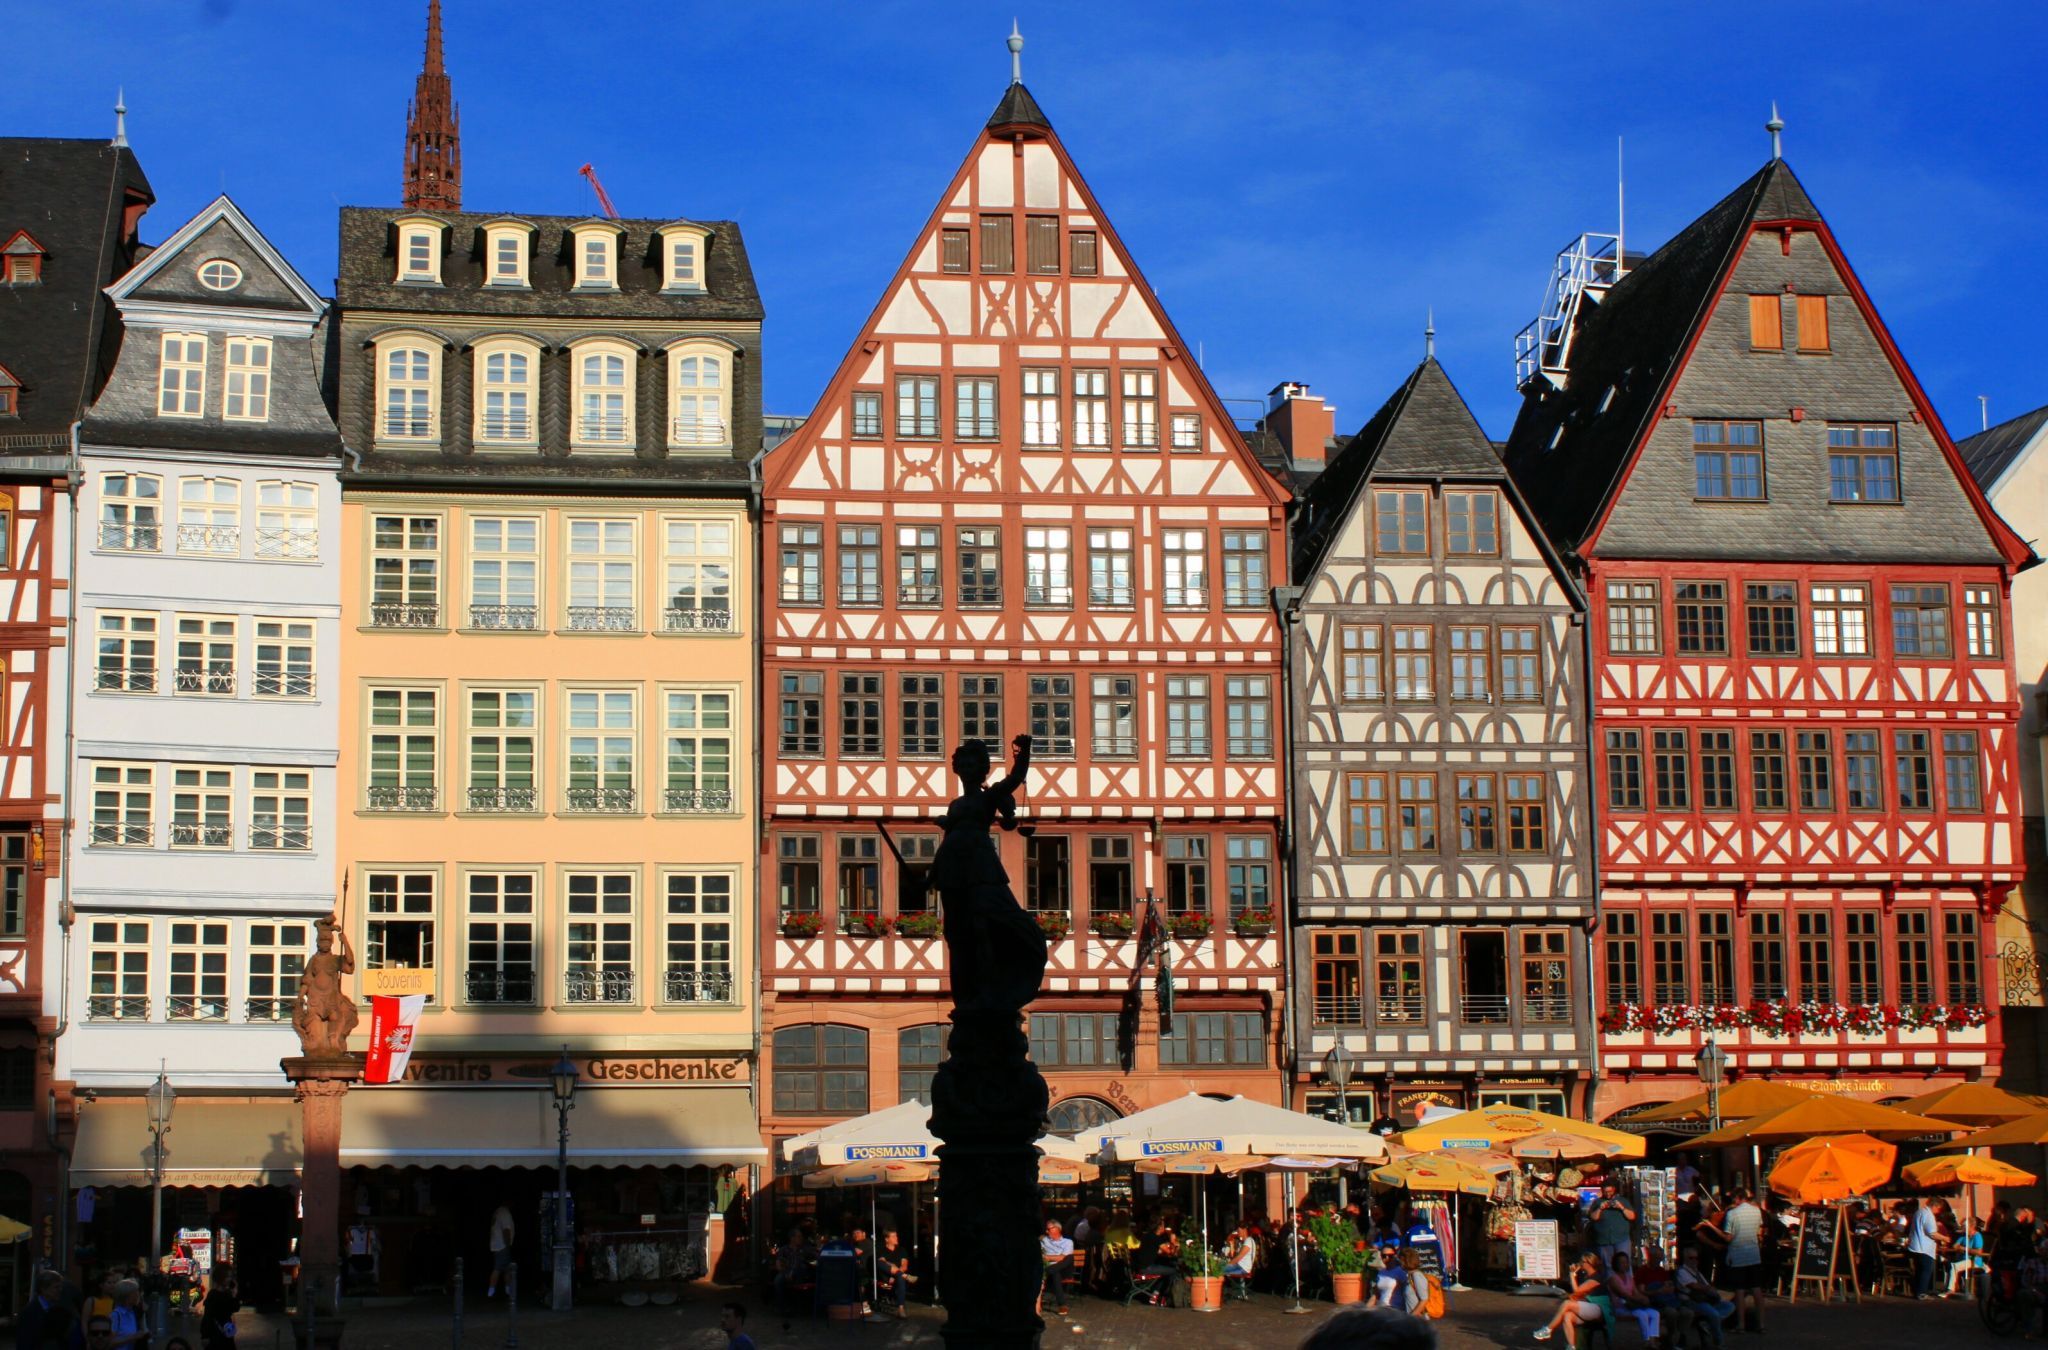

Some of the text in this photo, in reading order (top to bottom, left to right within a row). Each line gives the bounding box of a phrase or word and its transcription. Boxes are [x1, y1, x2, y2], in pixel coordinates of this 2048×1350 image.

[377, 970, 423, 990] Souvenirs
[402, 1058, 492, 1081] venirs
[587, 1058, 737, 1080] Geschenke
[1397, 1092, 1455, 1108] FRANKFURTER
[852, 1146, 920, 1158] POSSMANN
[1148, 1141, 1218, 1153] POSSMANN
